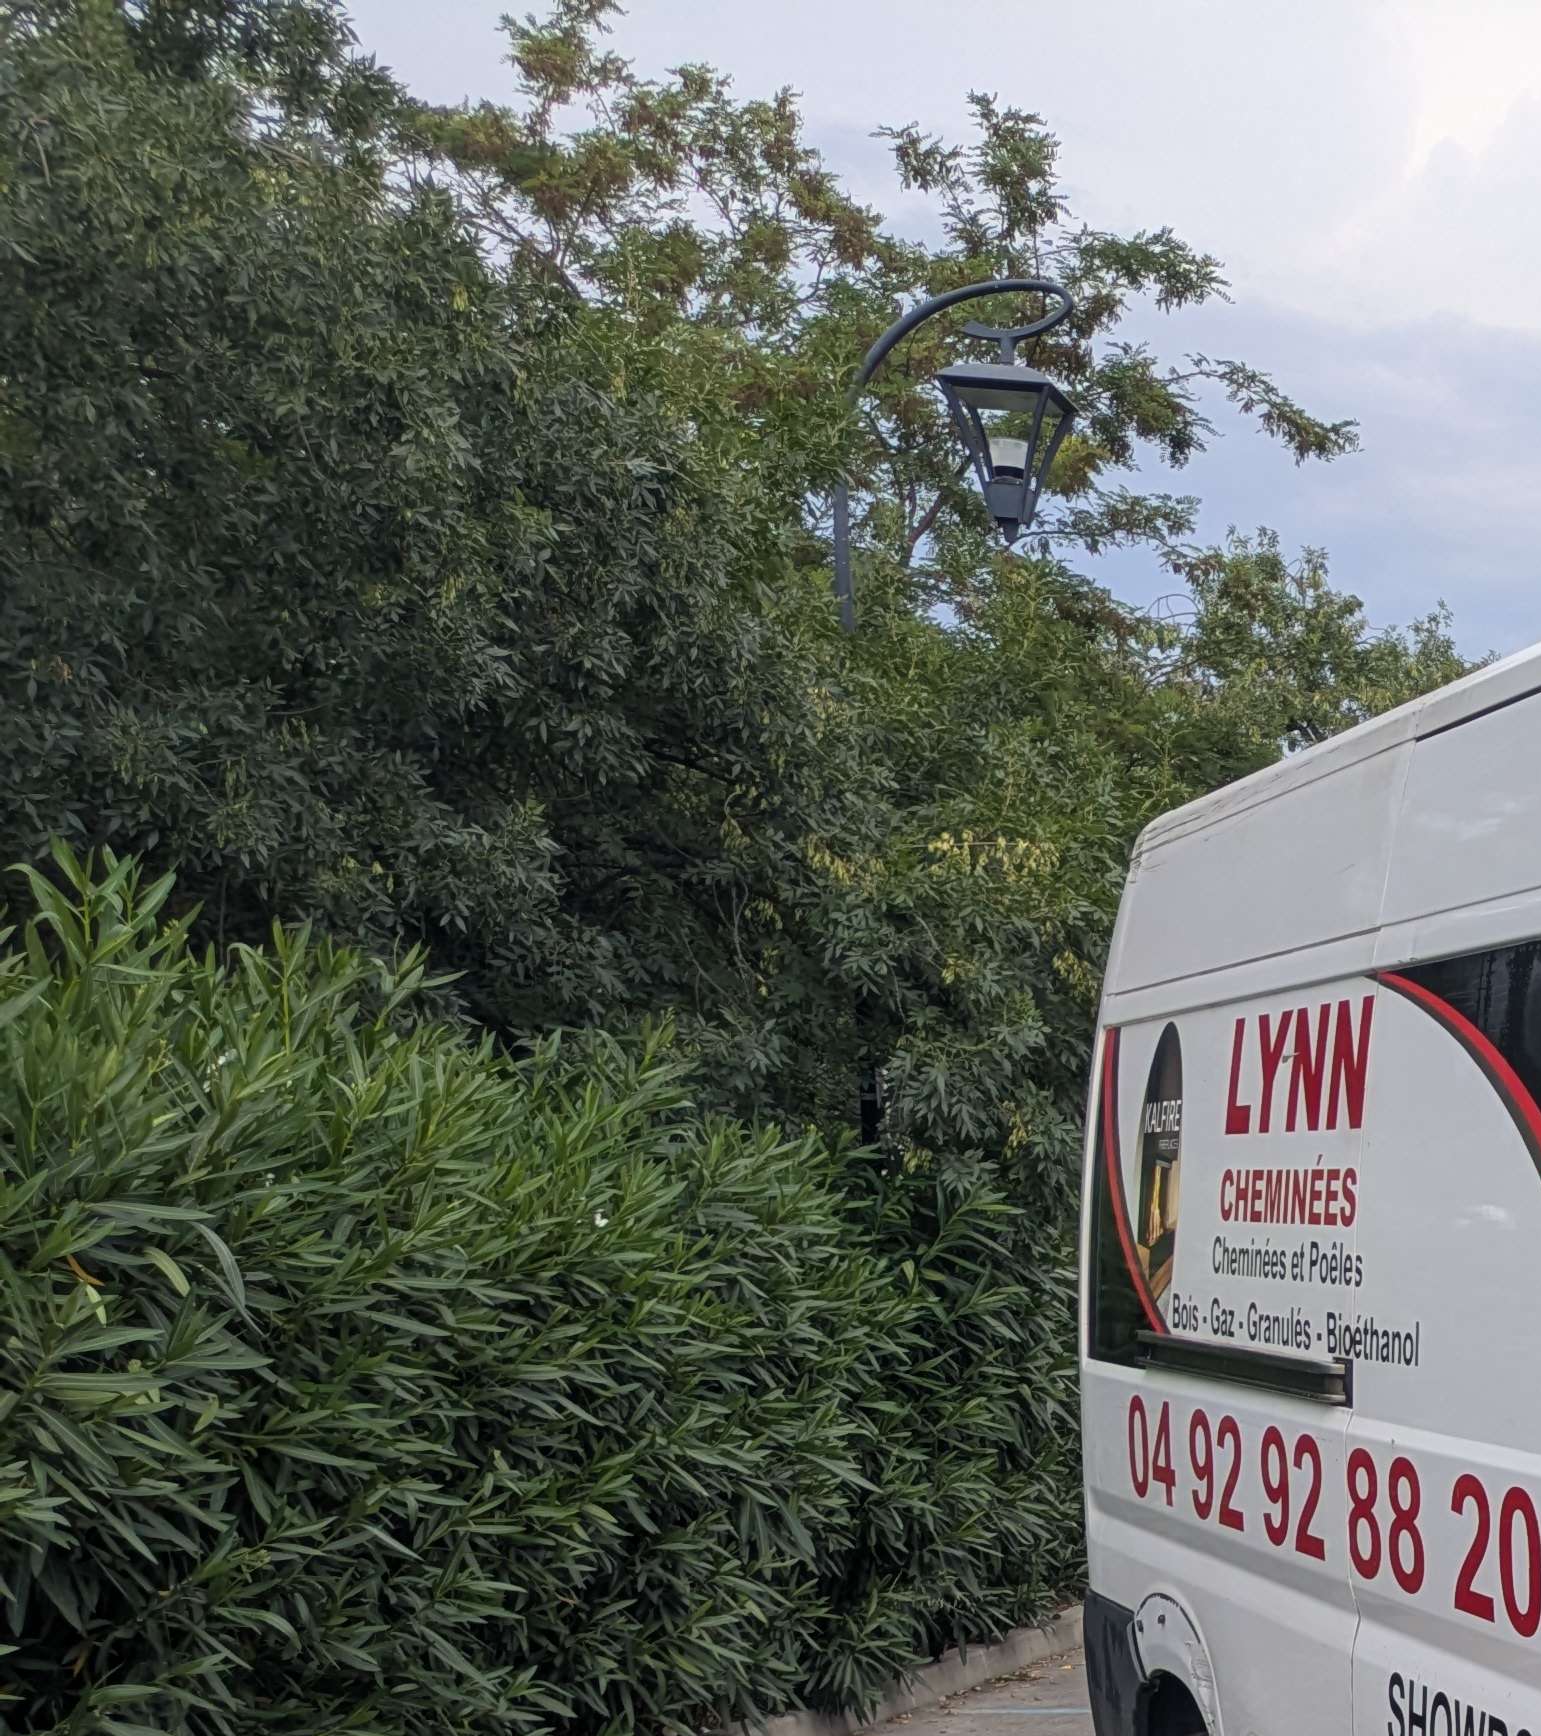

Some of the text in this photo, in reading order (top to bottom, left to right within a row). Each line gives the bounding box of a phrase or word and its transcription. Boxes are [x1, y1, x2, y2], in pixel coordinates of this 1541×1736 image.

[1225, 995, 1374, 1135] LYNN
[1220, 1154, 1357, 1227] CHEMINÉES
[1212, 1236, 1363, 1287] Cheminées et Poêles
[1172, 1293, 1199, 1332] Bois
[1210, 1297, 1235, 1337] Gaz
[1247, 1302, 1311, 1350] Granulés
[1327, 1311, 1420, 1366] Bioéthanol
[1128, 1395, 1175, 1507] 04
[1189, 1408, 1244, 1532] 92
[1261, 1425, 1325, 1561] 92
[1348, 1448, 1424, 1595] 88
